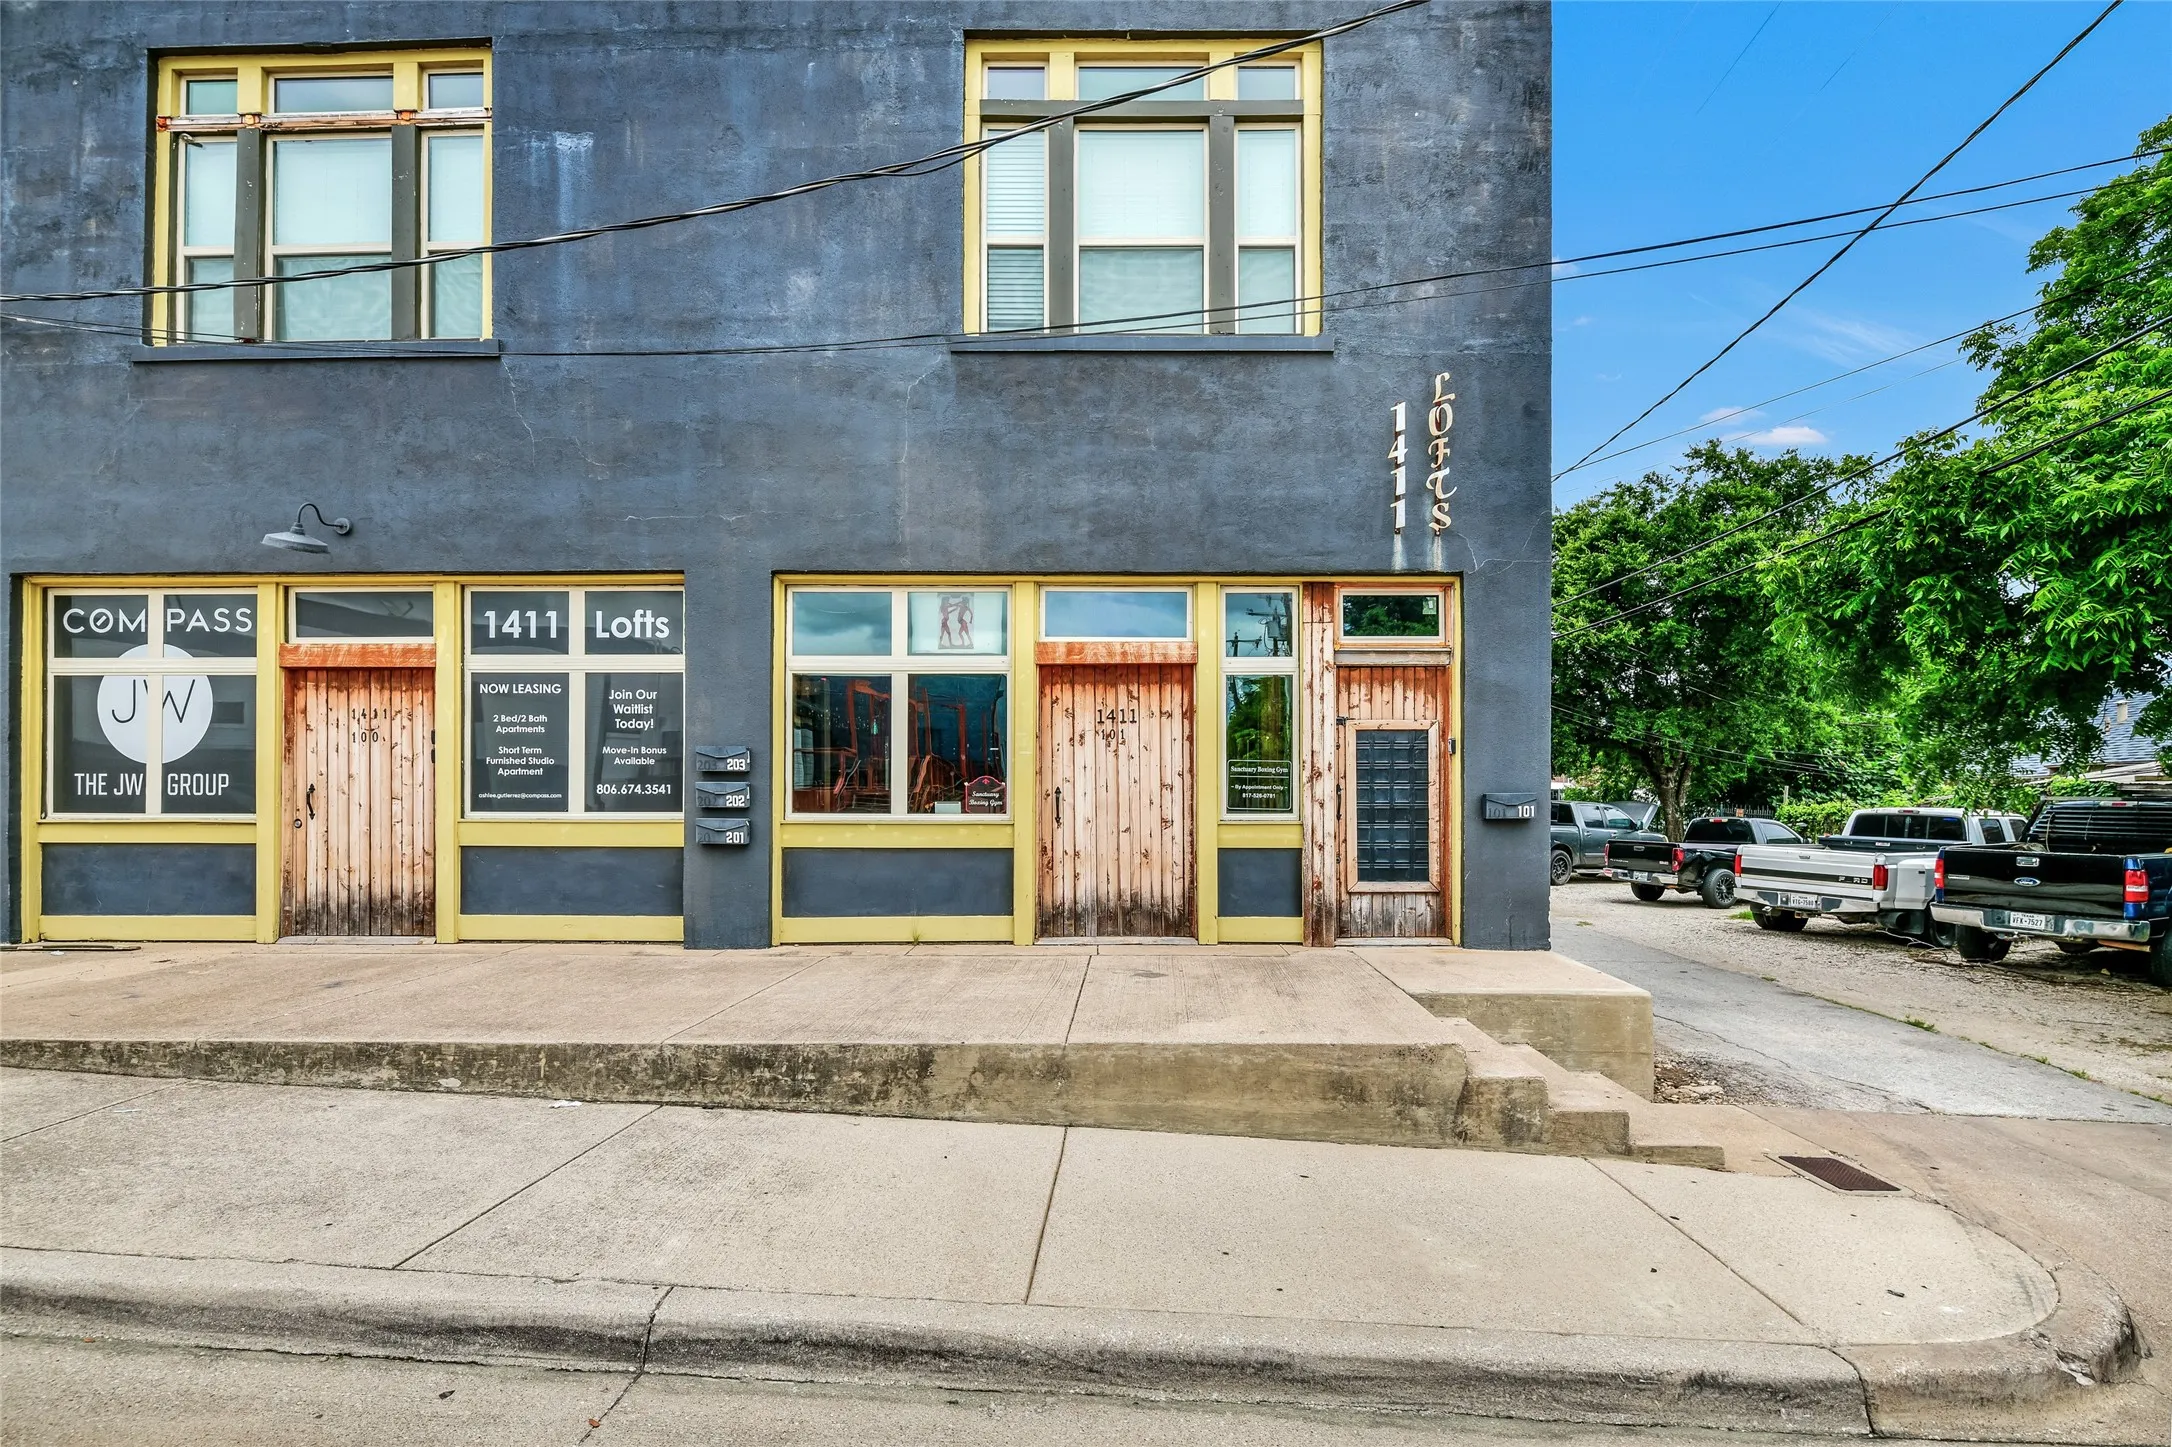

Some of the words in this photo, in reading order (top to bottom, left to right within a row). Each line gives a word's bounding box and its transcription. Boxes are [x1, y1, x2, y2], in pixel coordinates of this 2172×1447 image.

[1425, 372, 1457, 531] LOFTS
[1387, 401, 1408, 529] 1411
[62, 607, 253, 634] COMPASS
[484, 610, 557, 639] 1411
[596, 609, 670, 639] Lofts
[479, 683, 510, 695] NOW
[512, 683, 562, 695] LEASING
[609, 688, 632, 701] Join
[635, 689, 658, 701] Our
[351, 708, 387, 720] 1411
[613, 703, 653, 715] Waitlist
[493, 714, 499, 723] 2
[500, 714, 527, 724] Bed/2
[528, 714, 548, 723] Bath
[1096, 708, 1137, 725] 1411
[495, 724, 545, 735] Apartments
[614, 718, 654, 731] Today!
[352, 731, 379, 743] 100
[1100, 729, 1125, 740] 101
[498, 746, 519, 755] Short
[520, 746, 542, 755] Term
[602, 745, 639, 755] Move-In
[641, 746, 667, 755] Bonus
[486, 756, 526, 766] Furnished
[527, 756, 555, 766] Studio
[614, 756, 655, 766] Available
[726, 758, 746, 770] 203
[497, 766, 543, 777] Apartment
[1257, 766, 1275, 774] Boxing
[74, 773, 107, 796] THE
[113, 773, 143, 796] JW
[167, 773, 230, 797] GROUP
[596, 783, 672, 795] 806.674.3541
[726, 795, 745, 806] 202
[971, 790, 1000, 799] Sanctuary
[969, 799, 989, 807] Boxing
[1517, 805, 1535, 818] 101
[726, 831, 744, 843] 201
